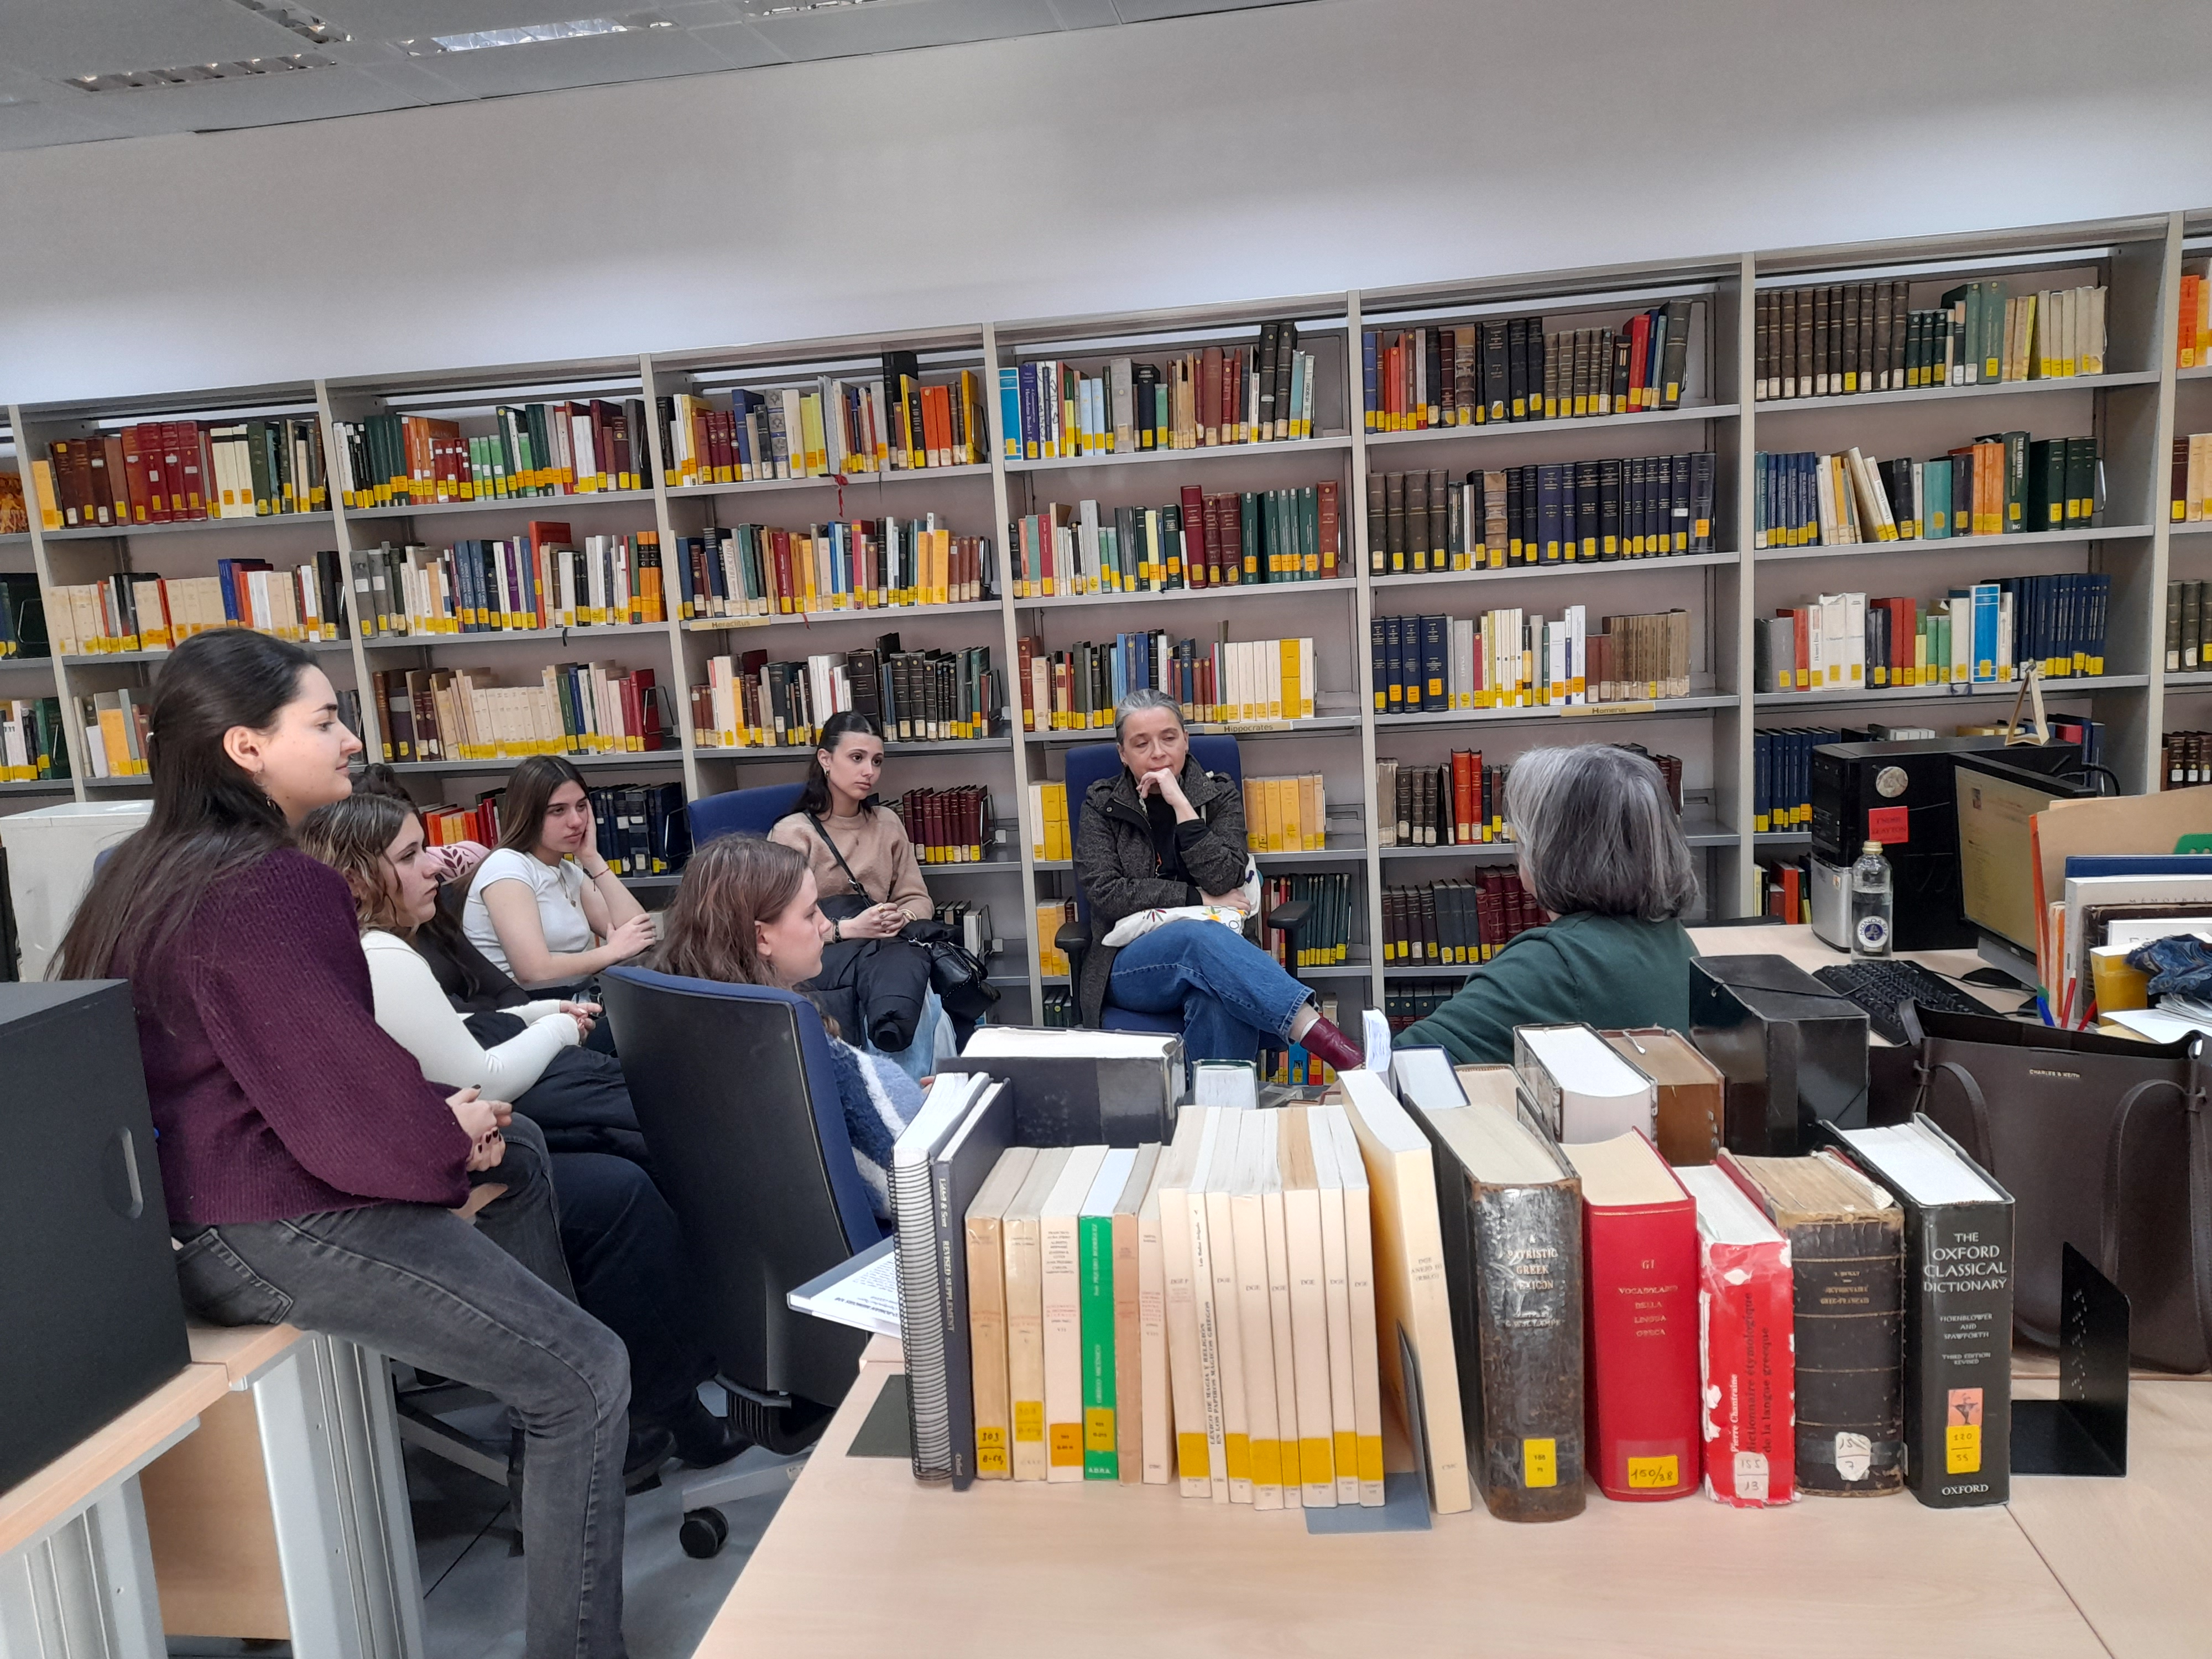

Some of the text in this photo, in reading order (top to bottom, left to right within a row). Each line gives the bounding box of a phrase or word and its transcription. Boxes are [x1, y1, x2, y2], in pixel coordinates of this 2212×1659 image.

[712, 620, 750, 628] Heraclitus
[1224, 724, 1274, 733] Hippocrates
[1860, 918, 1887, 936] MONDARIZ
[1953, 1232, 1979, 1243] THE
[1932, 1245, 2000, 1261] OXFORD
[1516, 1265, 1549, 1275] GREEK
[1924, 1261, 2007, 1278] CLASSICAL
[943, 1240, 955, 1332] REVISED SUPPLEMENT
[1618, 1285, 1678, 1295] VOCABOLARIO
[1924, 1279, 2007, 1293] DICTIONARY
[1204, 1301, 1213, 1338] GRIEGOS
[1634, 1315, 1666, 1323] LINGUA
[1939, 1313, 1993, 1322] HORNBLOWER
[1636, 1329, 1666, 1337] GRECA
[1944, 1332, 1989, 1340] SPAWFORTH
[1744, 1292, 1757, 1453] dictionnaire étymologique
[1761, 1327, 1773, 1453] de la langue grecque
[1206, 1401, 1213, 1412] DE
[1730, 1374, 1740, 1453] Pierre Chantraine
[1216, 1434, 1222, 1445] EN
[1942, 1484, 1989, 1495] OXFORD
